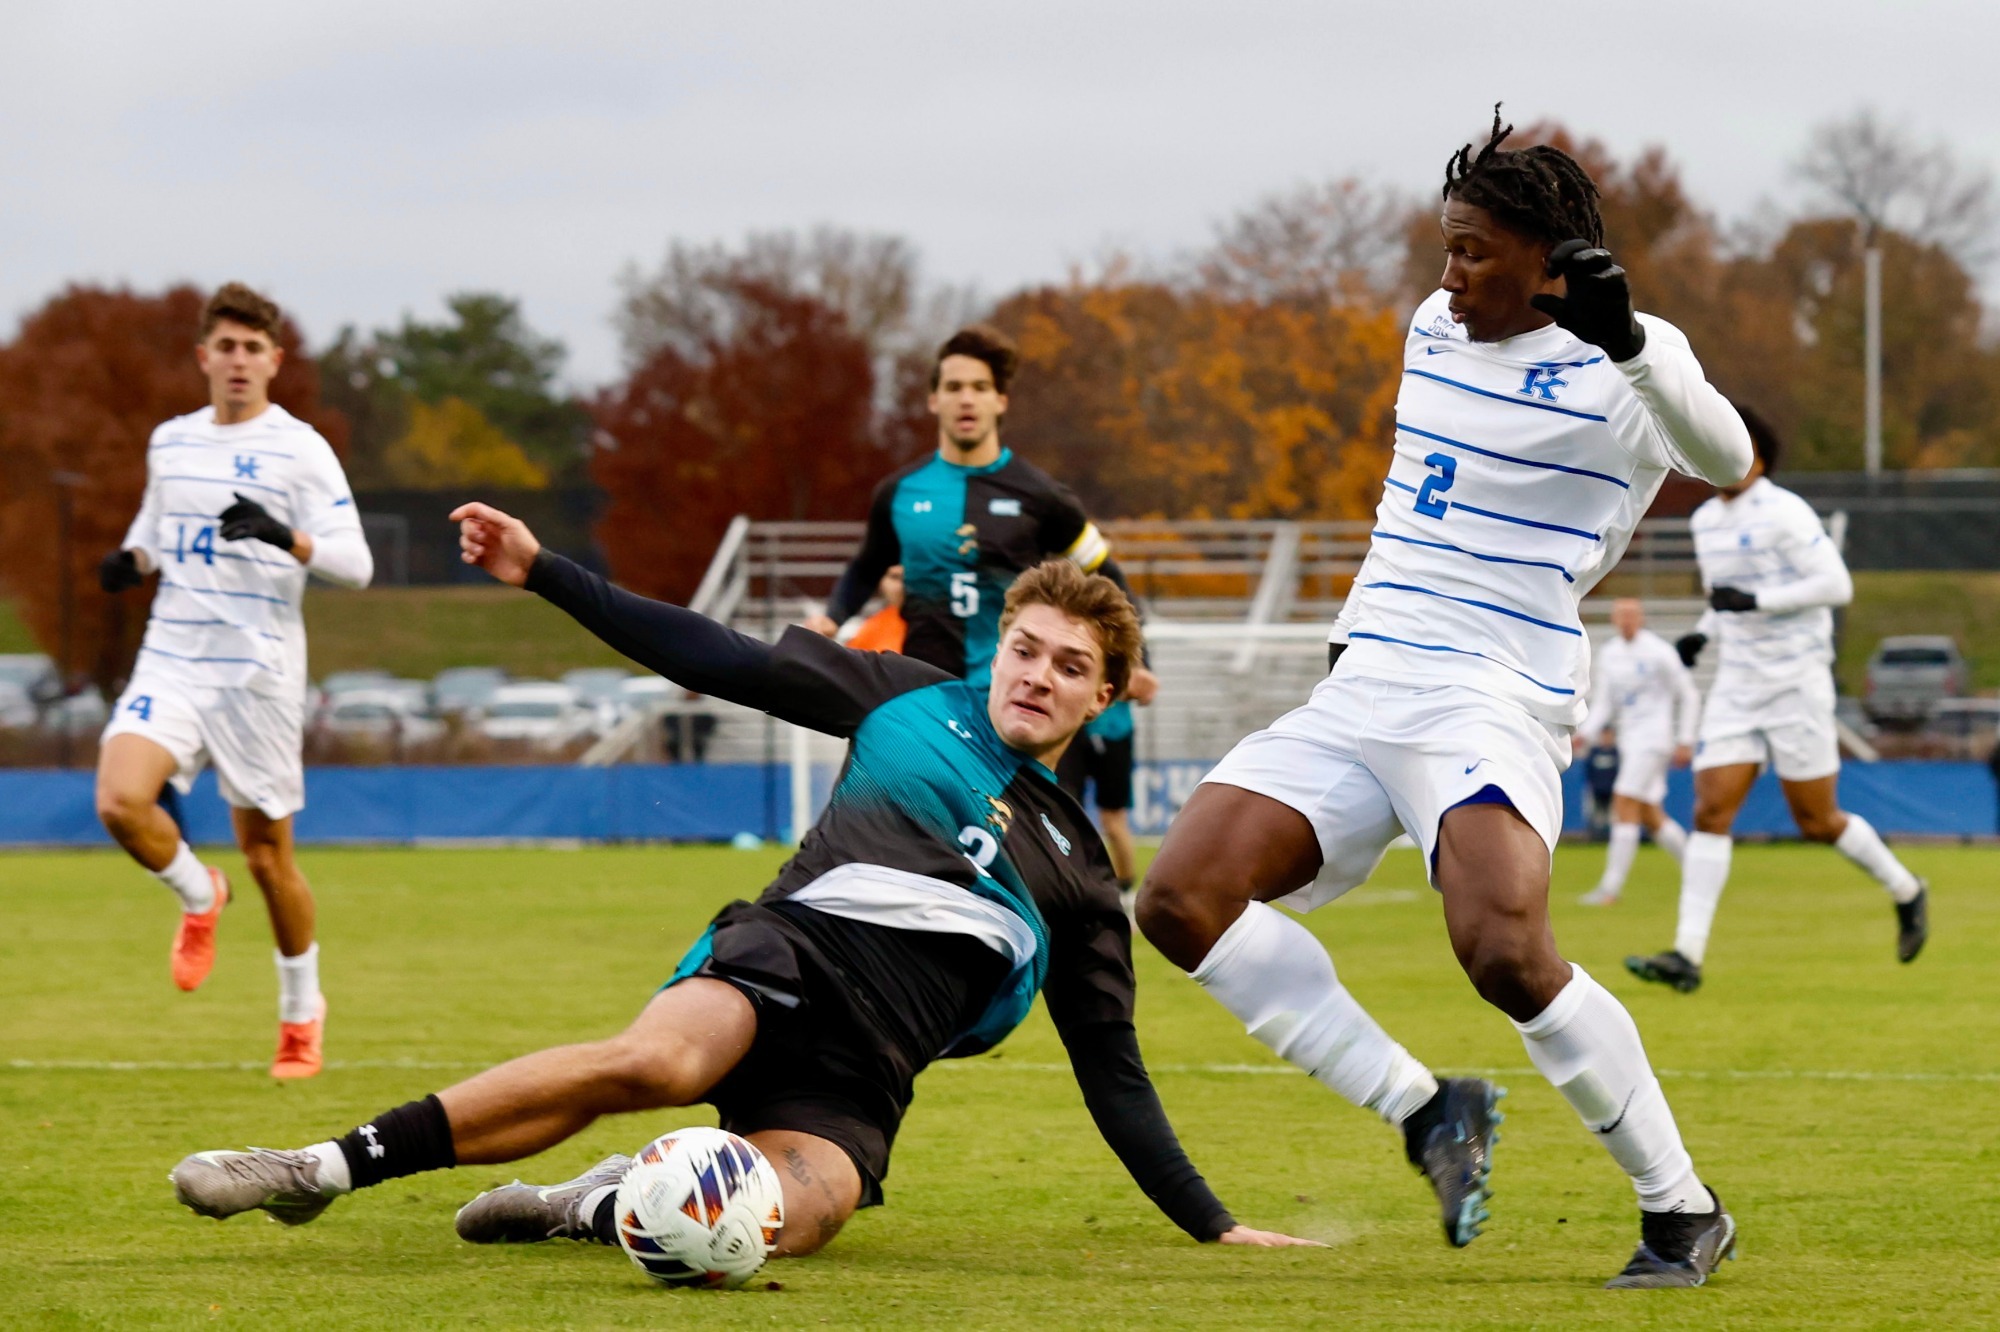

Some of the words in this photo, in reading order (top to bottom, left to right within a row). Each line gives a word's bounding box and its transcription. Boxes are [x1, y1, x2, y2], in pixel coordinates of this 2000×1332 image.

[1413, 452, 1457, 521] 2
[177, 523, 214, 566] 14
[951, 571, 980, 618] 5
